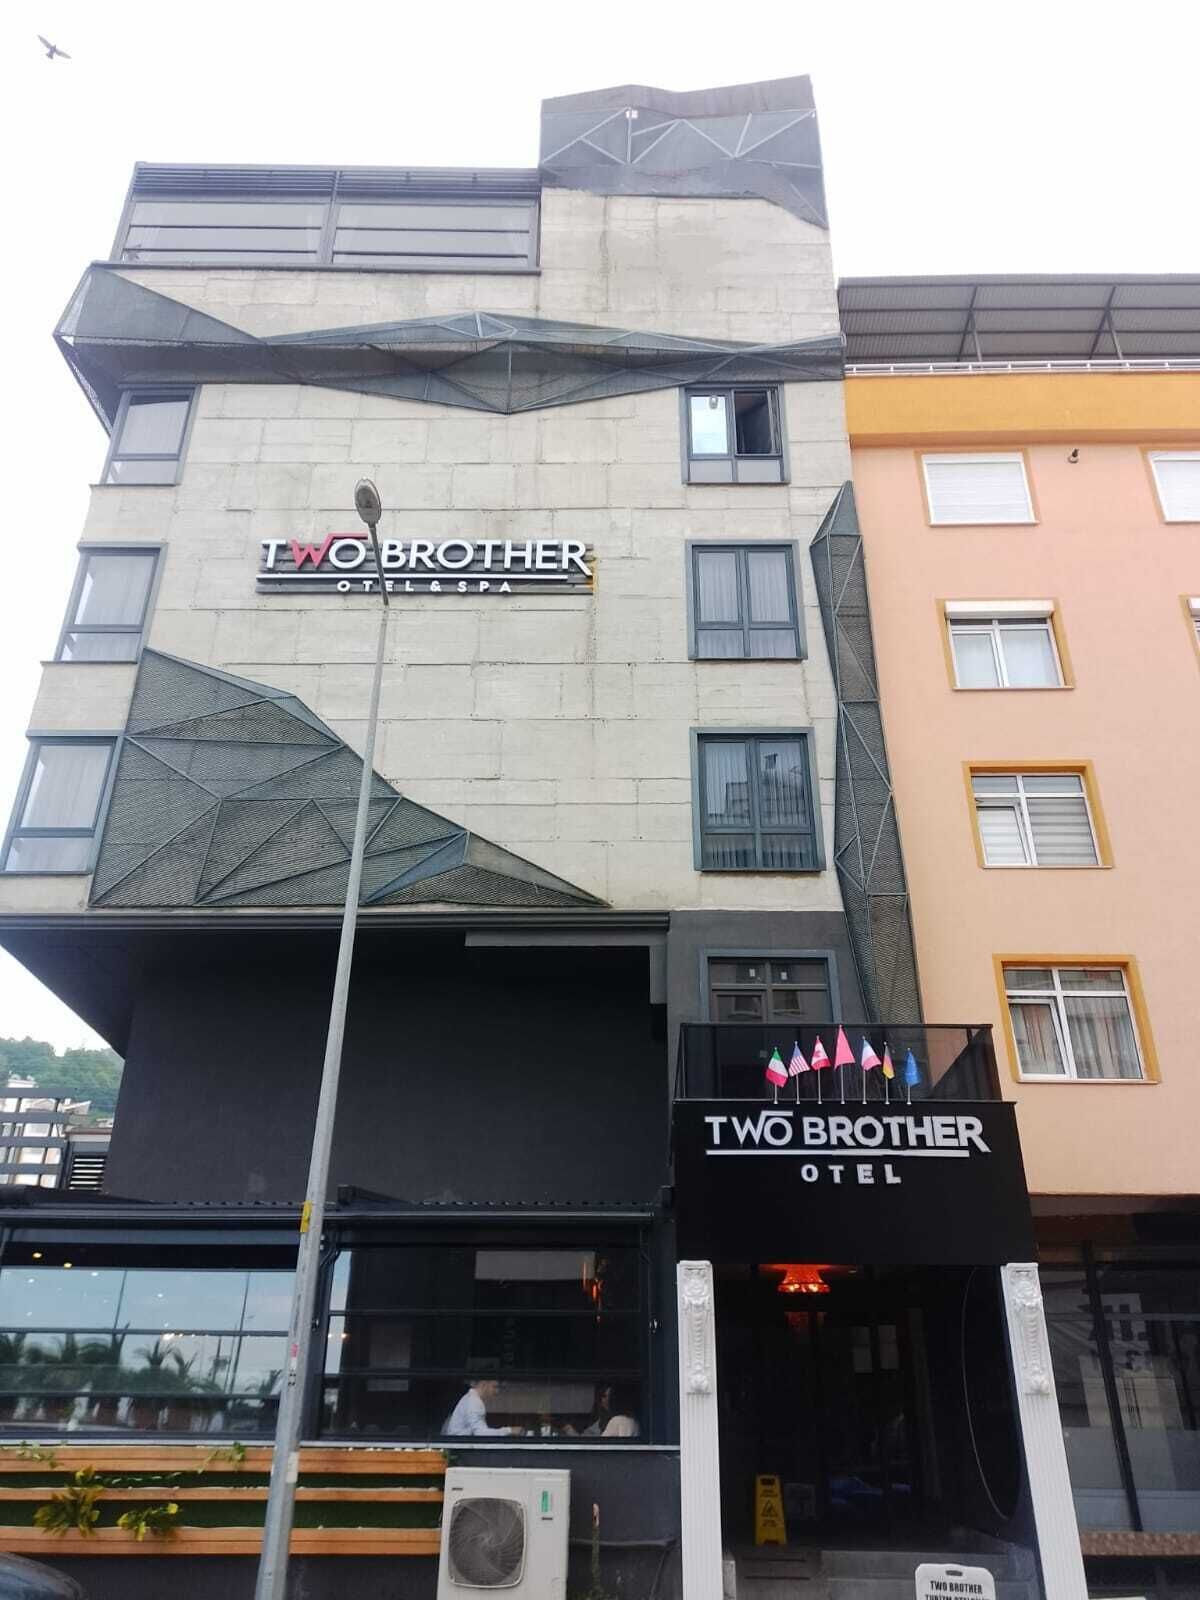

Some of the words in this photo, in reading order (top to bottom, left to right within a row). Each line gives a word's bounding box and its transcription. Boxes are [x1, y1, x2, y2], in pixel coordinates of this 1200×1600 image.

[262, 533, 369, 569] TWO
[381, 539, 593, 576] BROTHER
[337, 580, 413, 592] OTEL
[430, 580, 442, 592] &
[457, 580, 512, 592] SPA
[704, 1110, 793, 1147] TWO
[803, 1115, 992, 1153] BROTHER
[801, 1163, 901, 1184] OTEL
[930, 1580, 948, 1592] TWO
[949, 1582, 983, 1595] BROTHER
